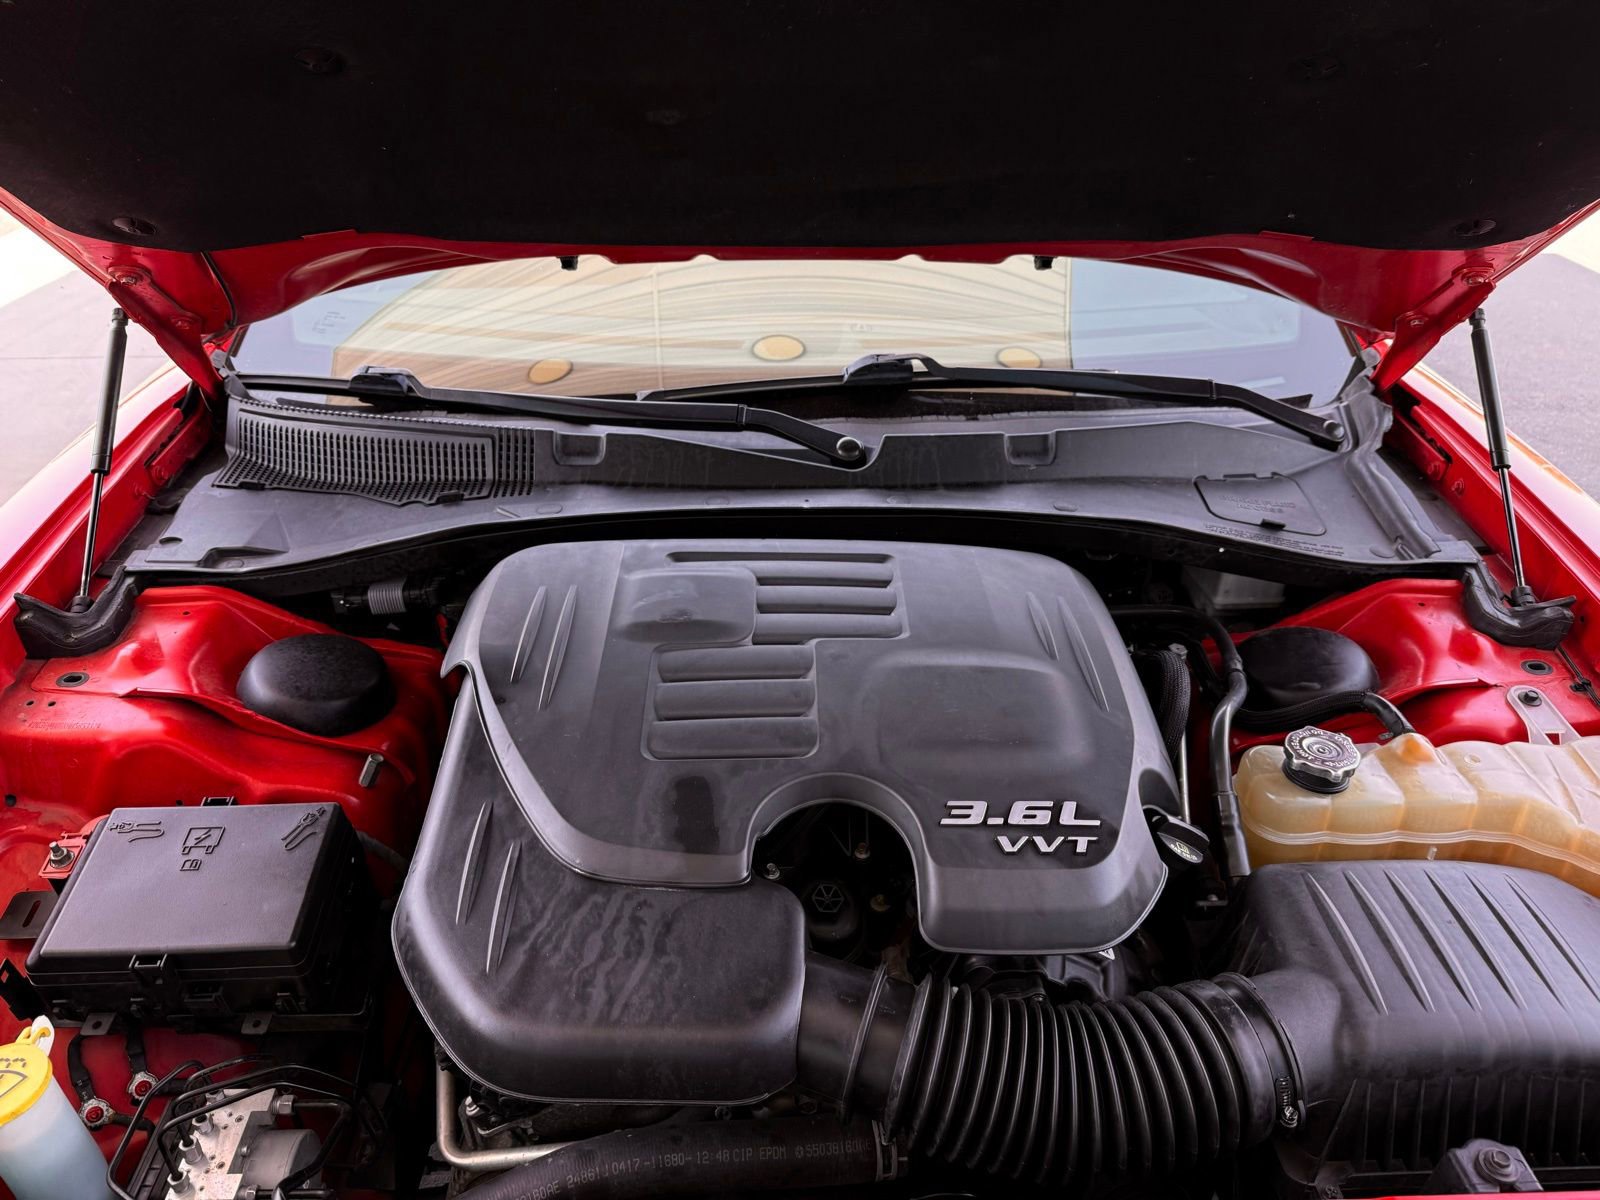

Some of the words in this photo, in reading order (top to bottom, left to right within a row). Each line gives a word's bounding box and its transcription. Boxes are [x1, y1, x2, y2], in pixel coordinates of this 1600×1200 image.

[940, 800, 1101, 826] 3.6L
[996, 835, 1099, 853] VVT
[759, 1145, 787, 1160] EPDM
